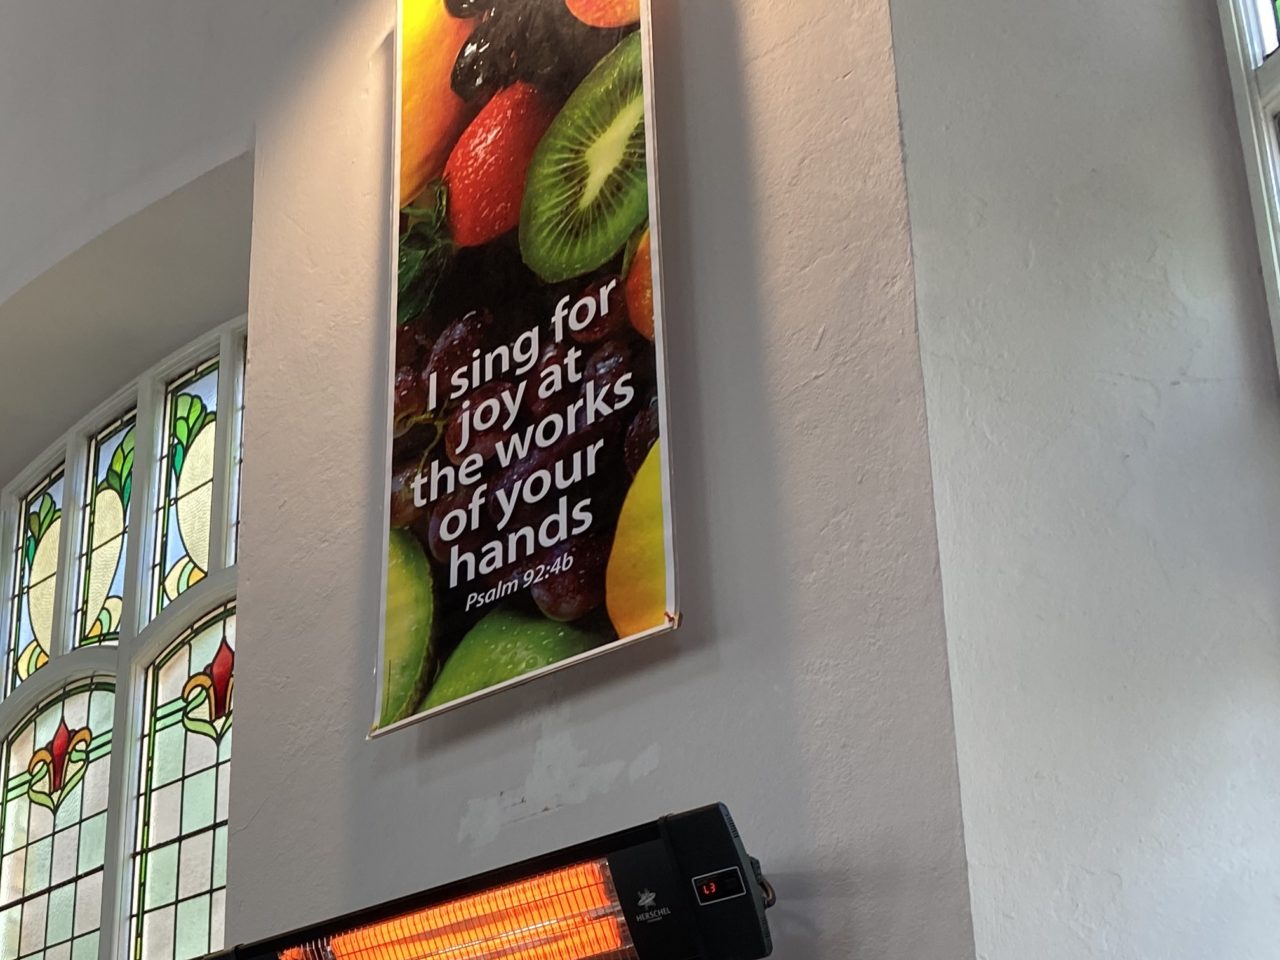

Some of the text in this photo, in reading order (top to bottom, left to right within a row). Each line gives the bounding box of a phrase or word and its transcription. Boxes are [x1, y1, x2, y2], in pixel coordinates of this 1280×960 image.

[429, 278, 617, 411] I sing for
[410, 371, 636, 509] the works
[455, 348, 582, 453] joy at
[438, 438, 605, 543] of your
[448, 494, 594, 590] hands
[465, 552, 575, 612] Psalm 92:4b
[635, 907, 671, 922] HERSCHEL
